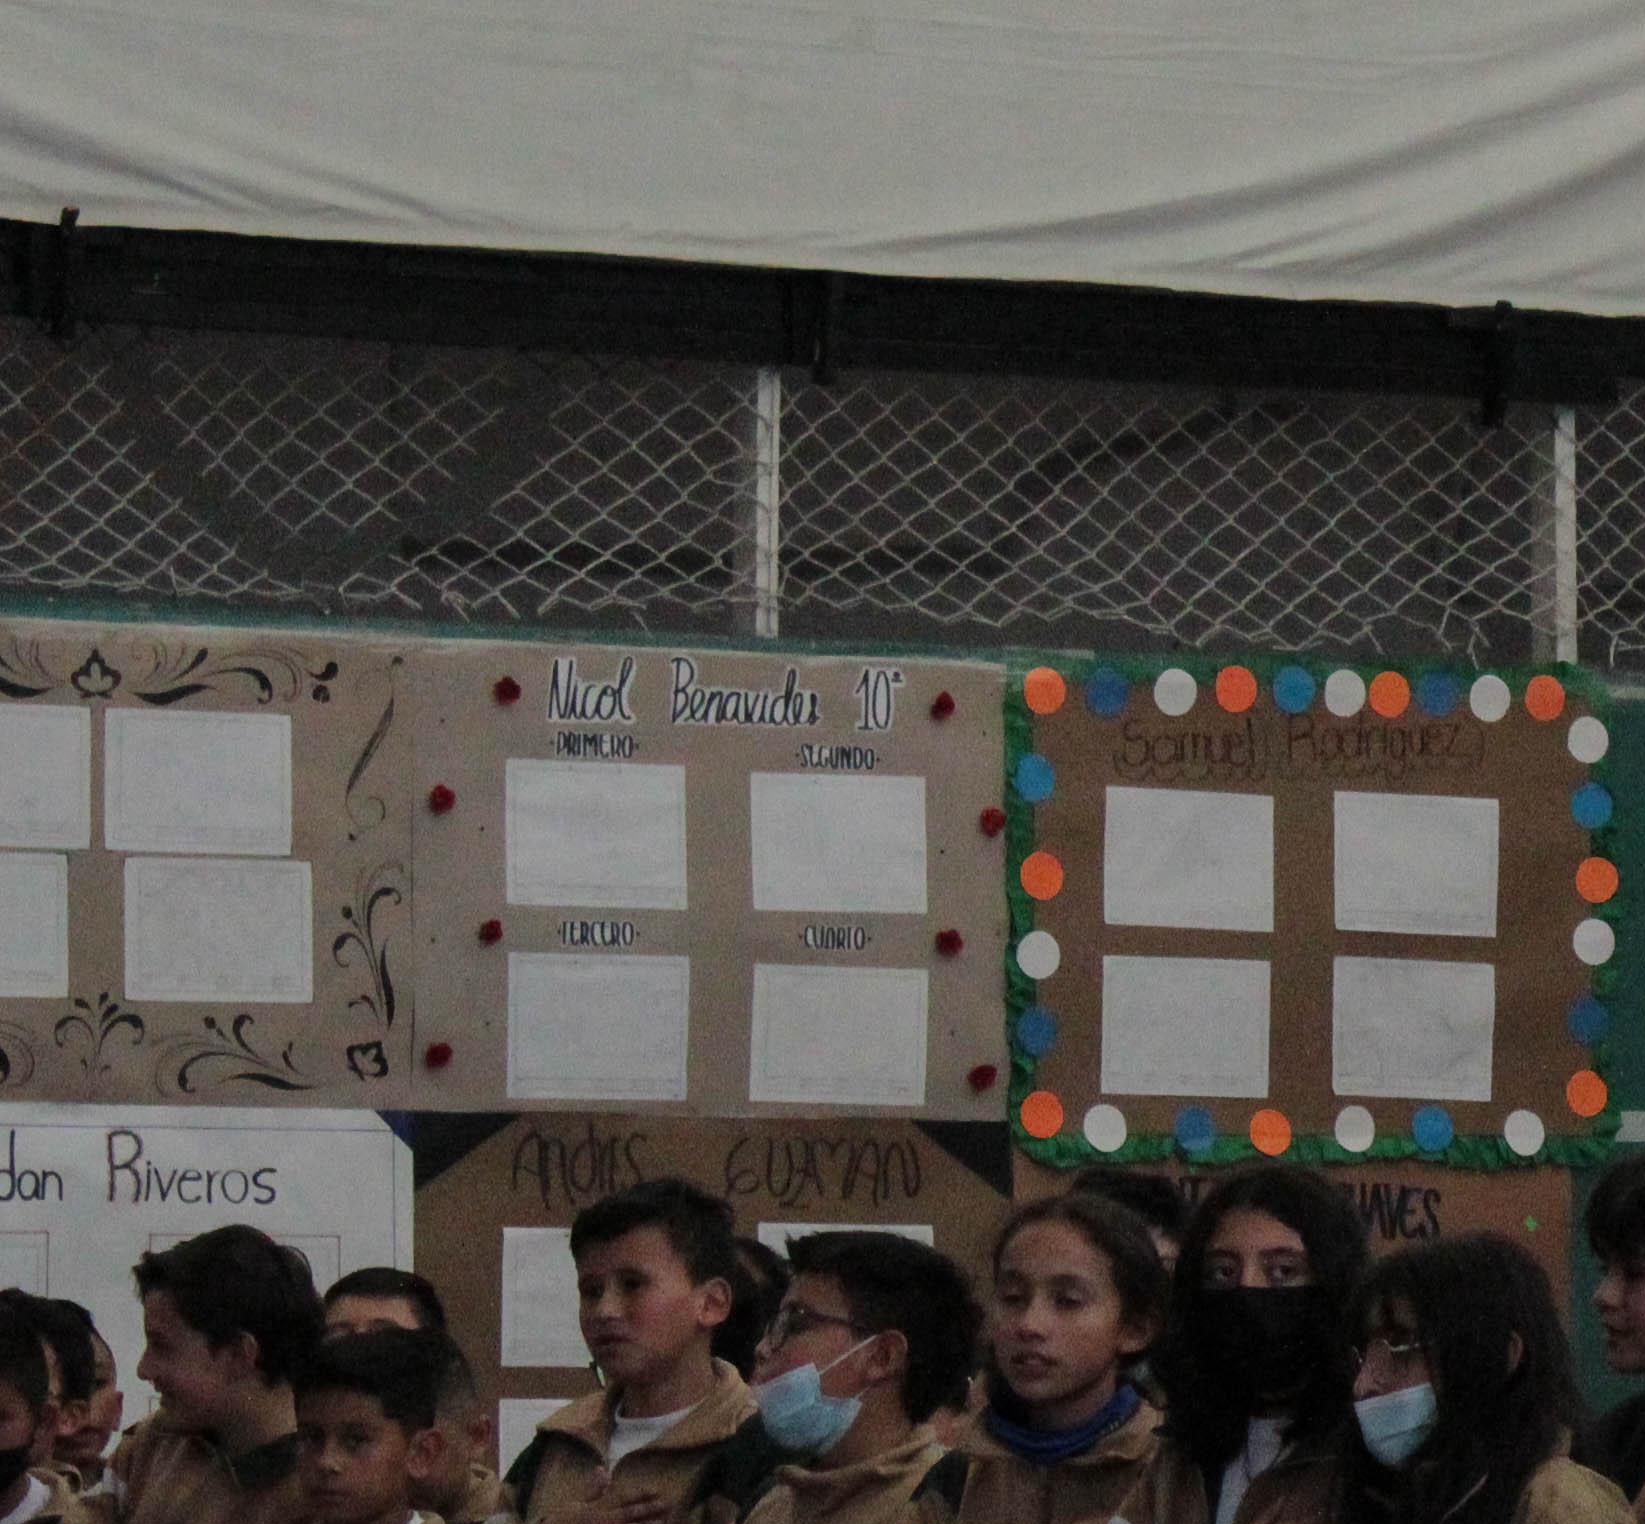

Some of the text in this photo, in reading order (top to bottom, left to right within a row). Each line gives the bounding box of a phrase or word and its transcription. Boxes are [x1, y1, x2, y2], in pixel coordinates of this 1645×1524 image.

[548, 656, 634, 721] Nicol
[671, 652, 820, 726] Benavides
[106, 1128, 279, 1204] Riveros
